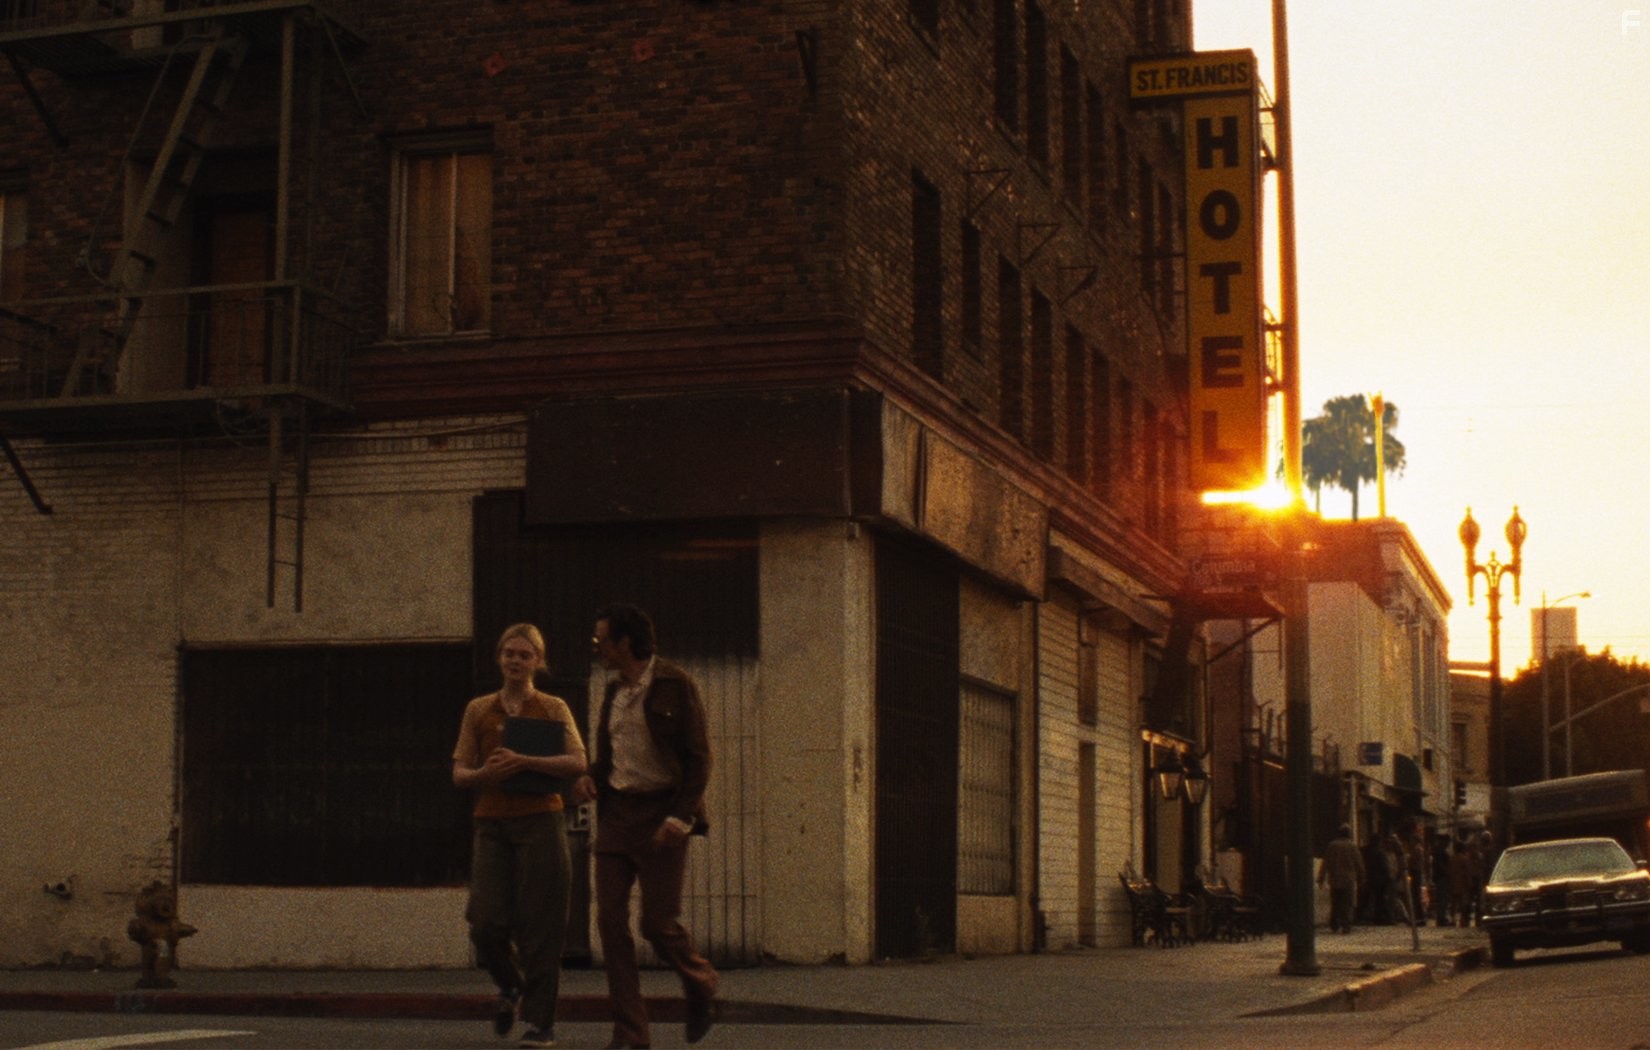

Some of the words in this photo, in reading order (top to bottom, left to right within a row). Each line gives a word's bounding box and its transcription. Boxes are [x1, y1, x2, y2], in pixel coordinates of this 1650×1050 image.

[1137, 68, 1162, 91] ST.
[1166, 62, 1248, 89] FRANCIS
[1197, 116, 1243, 464] HOTEL
